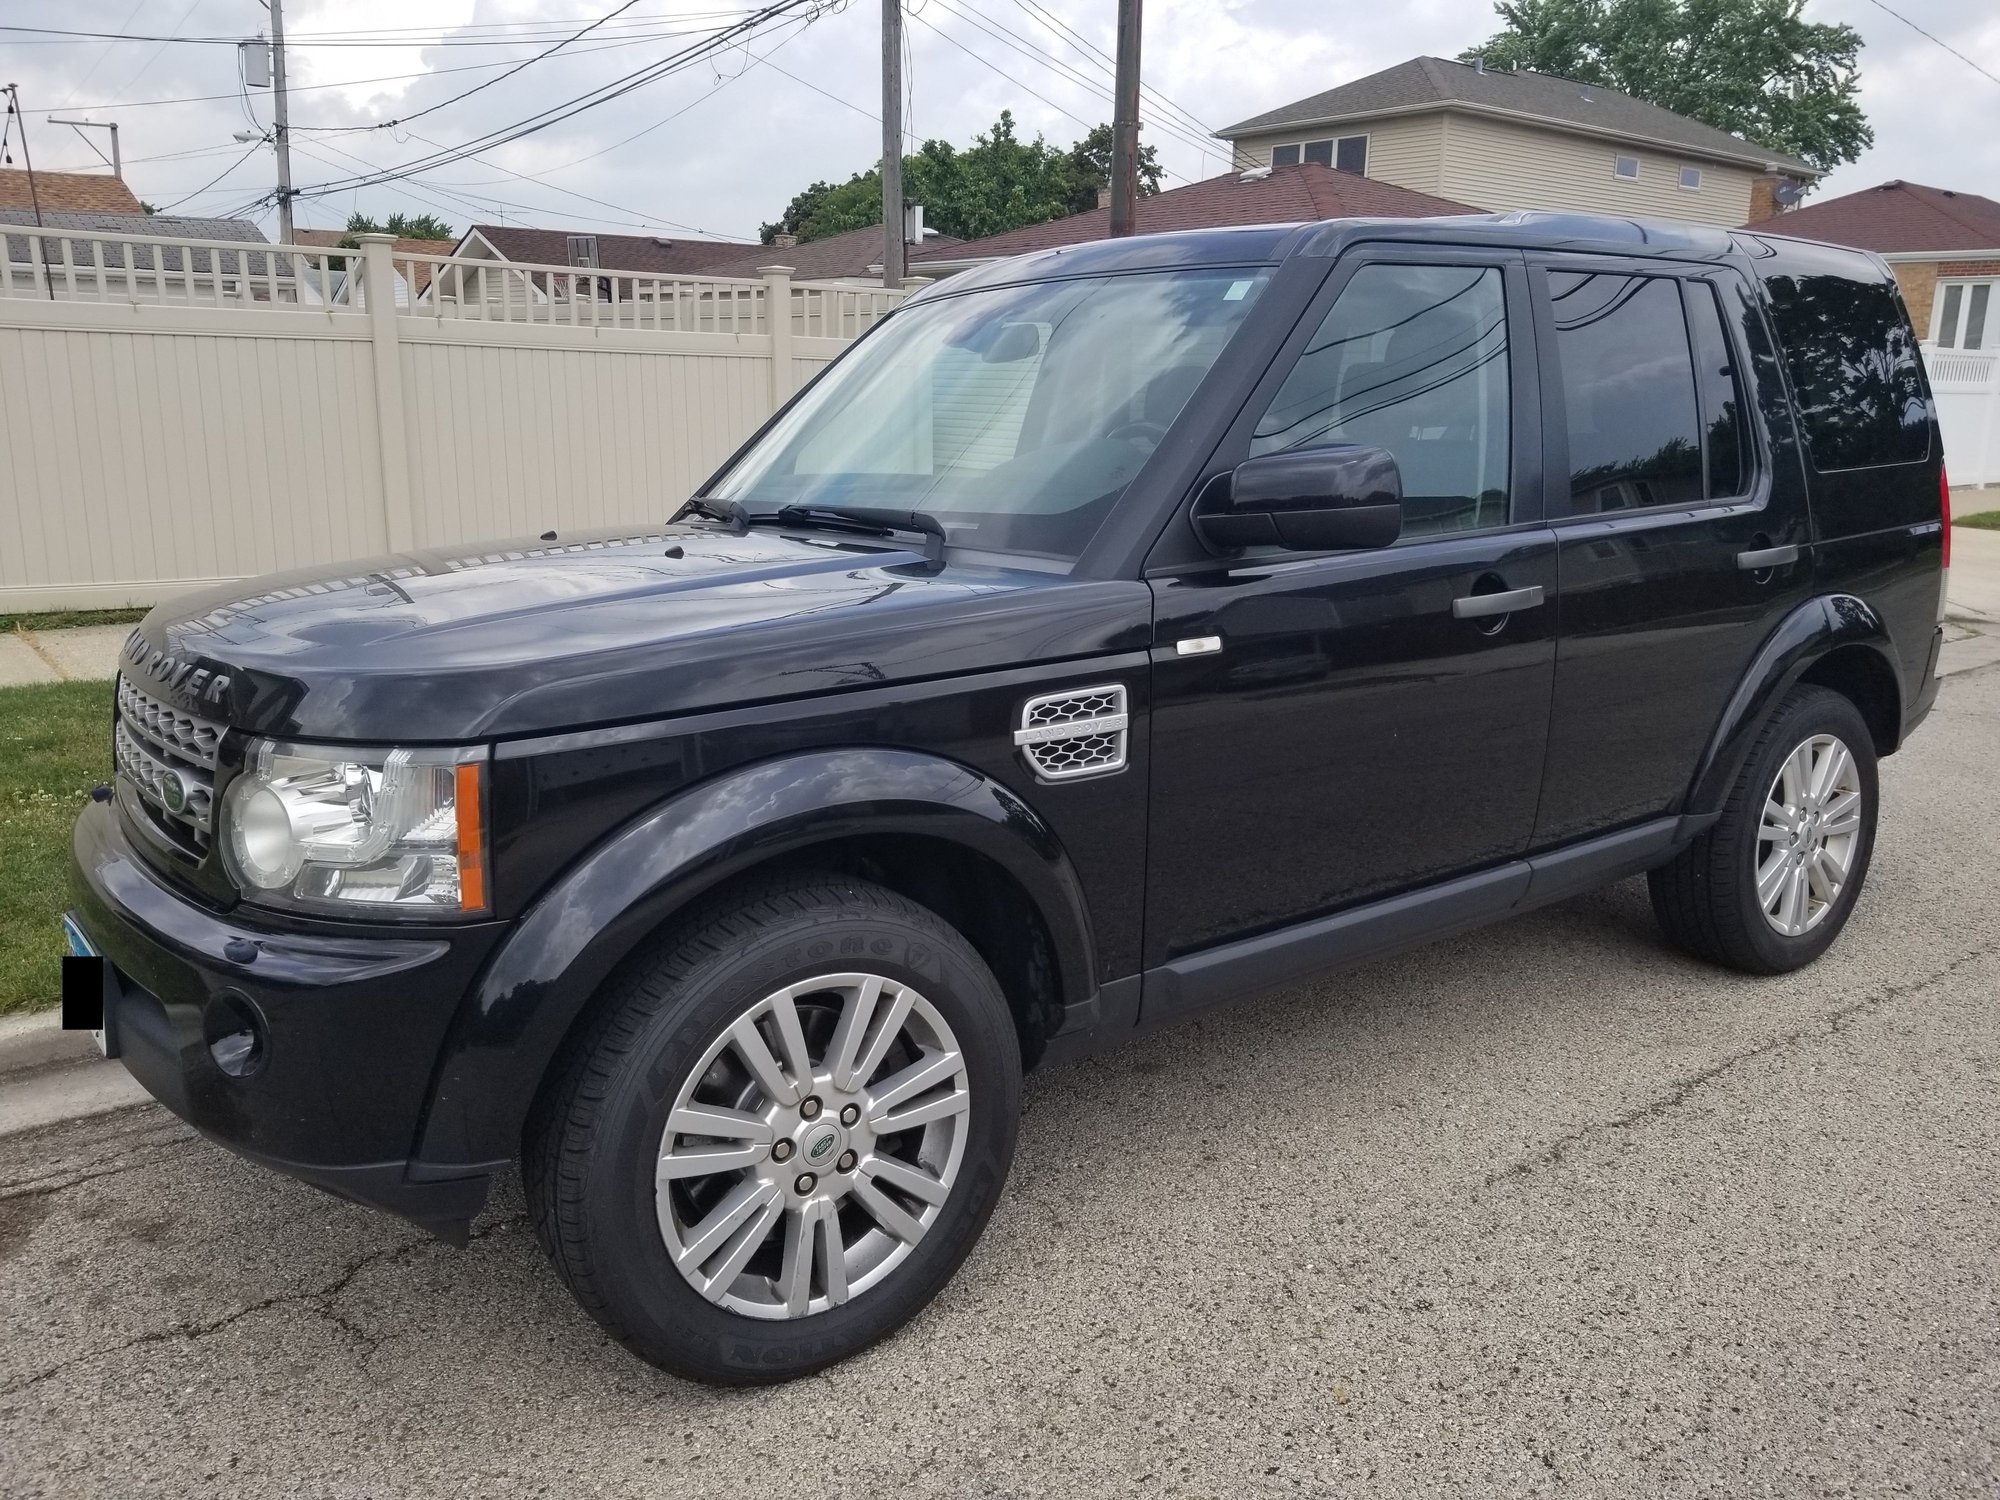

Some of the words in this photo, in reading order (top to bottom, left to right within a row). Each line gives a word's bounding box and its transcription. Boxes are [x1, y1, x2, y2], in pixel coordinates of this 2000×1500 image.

[145, 650, 231, 704] ROVER
[1024, 727, 1066, 741] LAND
[1073, 719, 1122, 735] ROVER
